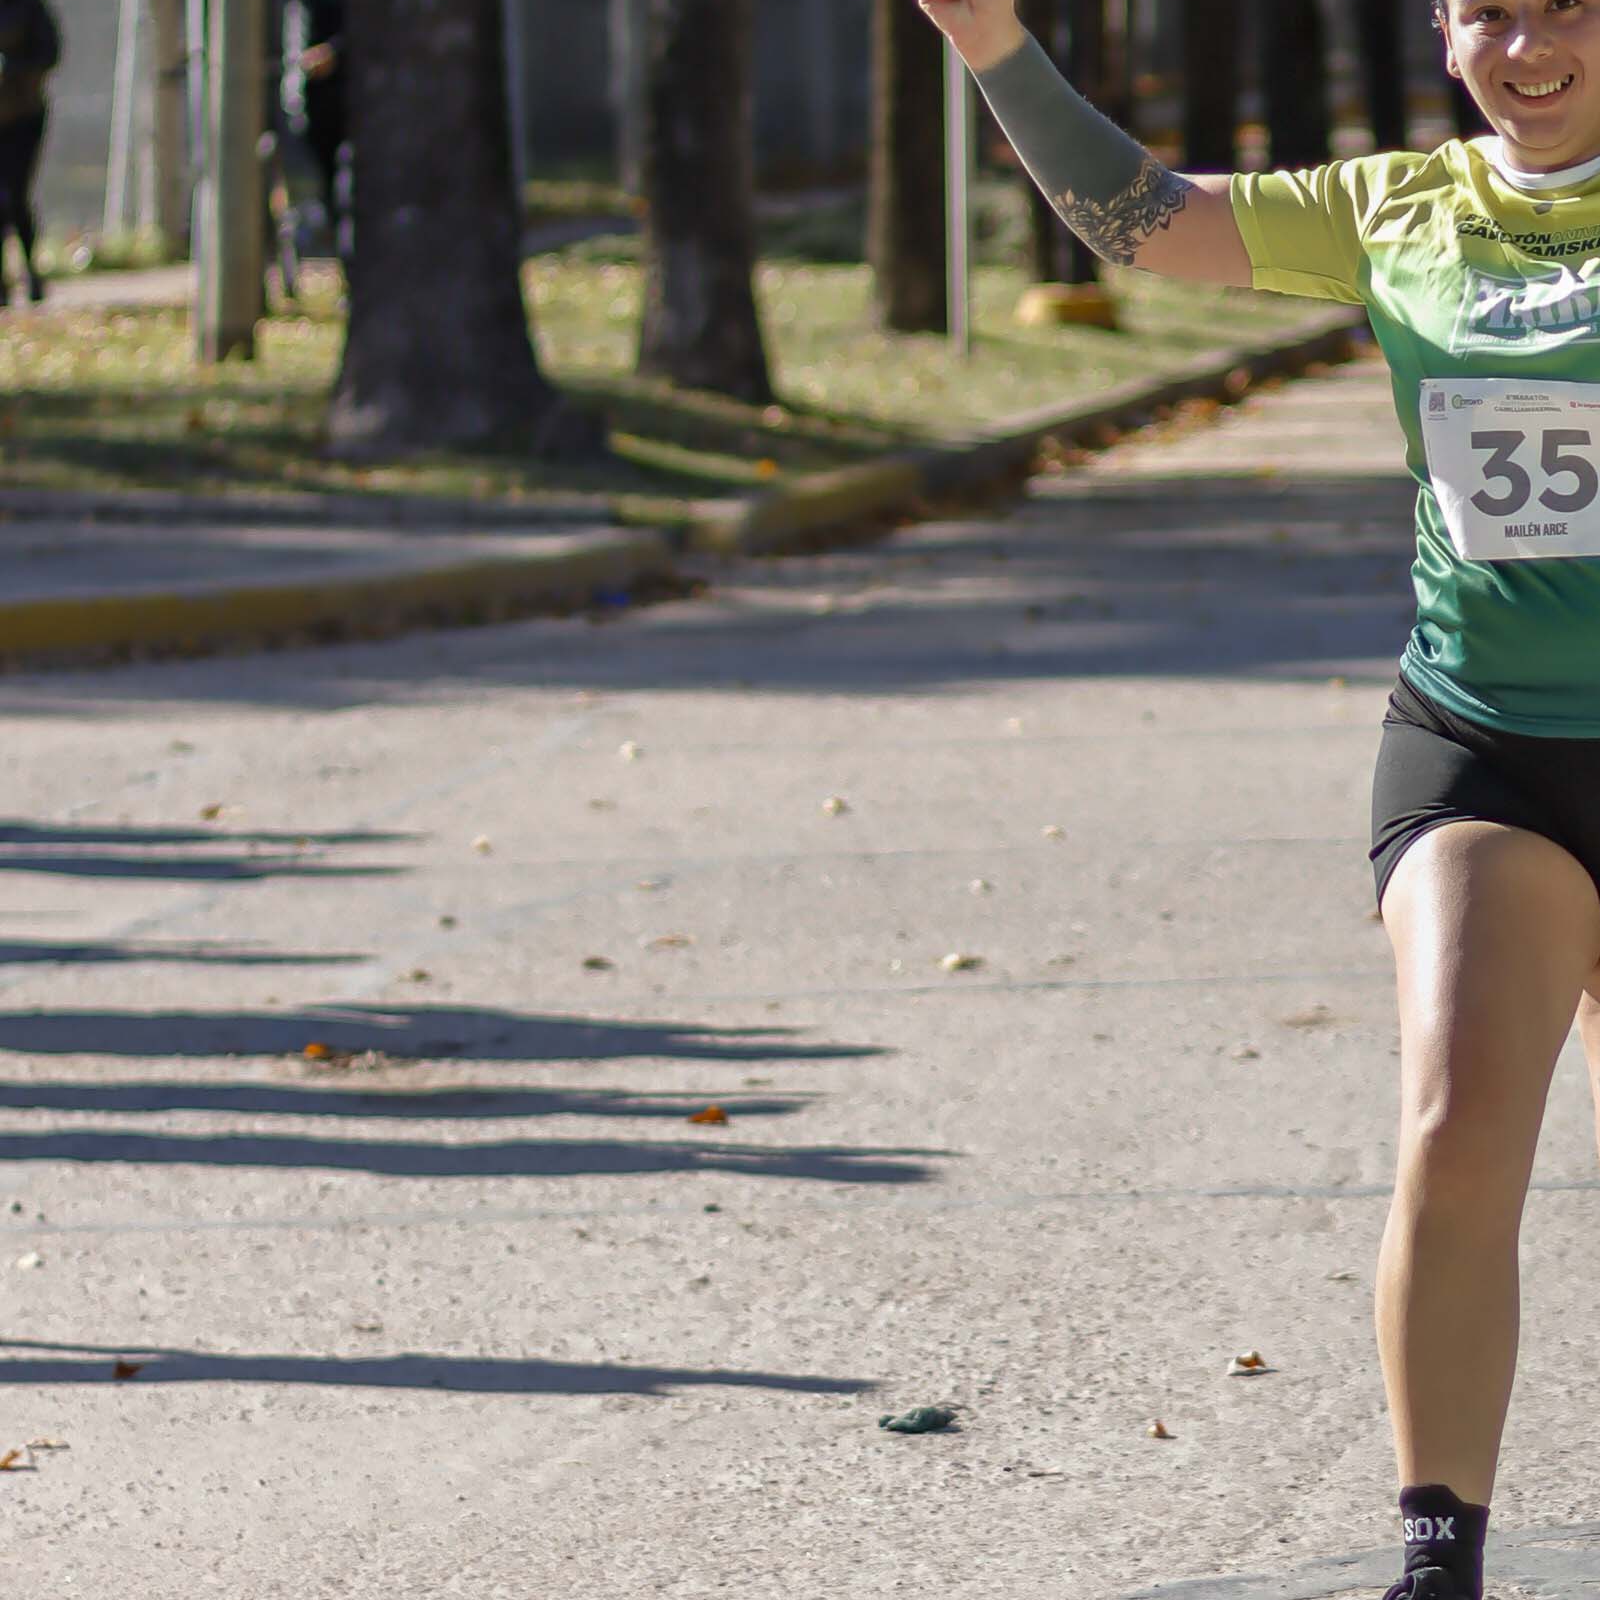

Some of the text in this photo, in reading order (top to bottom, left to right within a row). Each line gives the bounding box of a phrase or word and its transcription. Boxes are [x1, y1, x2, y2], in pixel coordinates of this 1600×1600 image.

[1470, 429, 1599, 517] 35
[1504, 521, 1569, 538] MAILÉN ARCE
[1404, 1516, 1456, 1541] SOX
